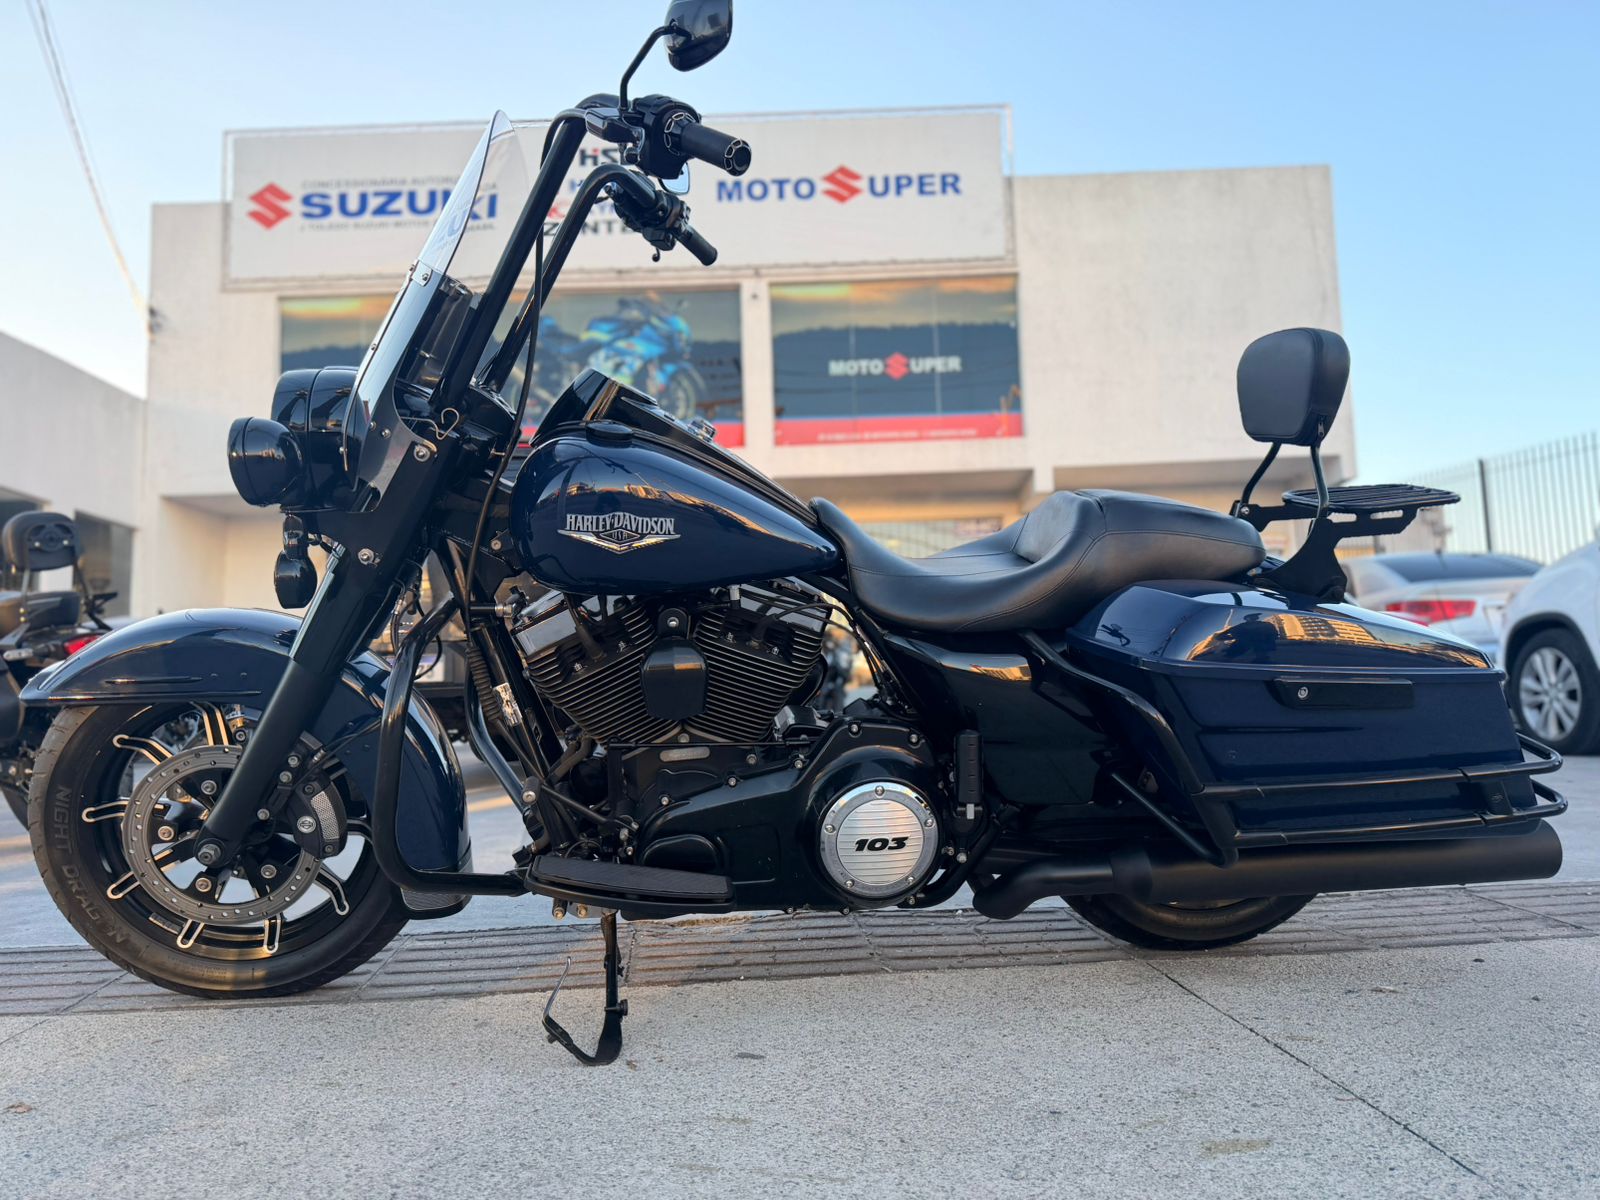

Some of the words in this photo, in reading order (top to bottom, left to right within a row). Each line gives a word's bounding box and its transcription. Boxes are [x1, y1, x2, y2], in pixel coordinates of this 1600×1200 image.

[716, 178, 817, 202] MOTO
[828, 359, 884, 376] MOTO
[54, 784, 73, 855] NIGHT
[855, 836, 909, 852] 103
